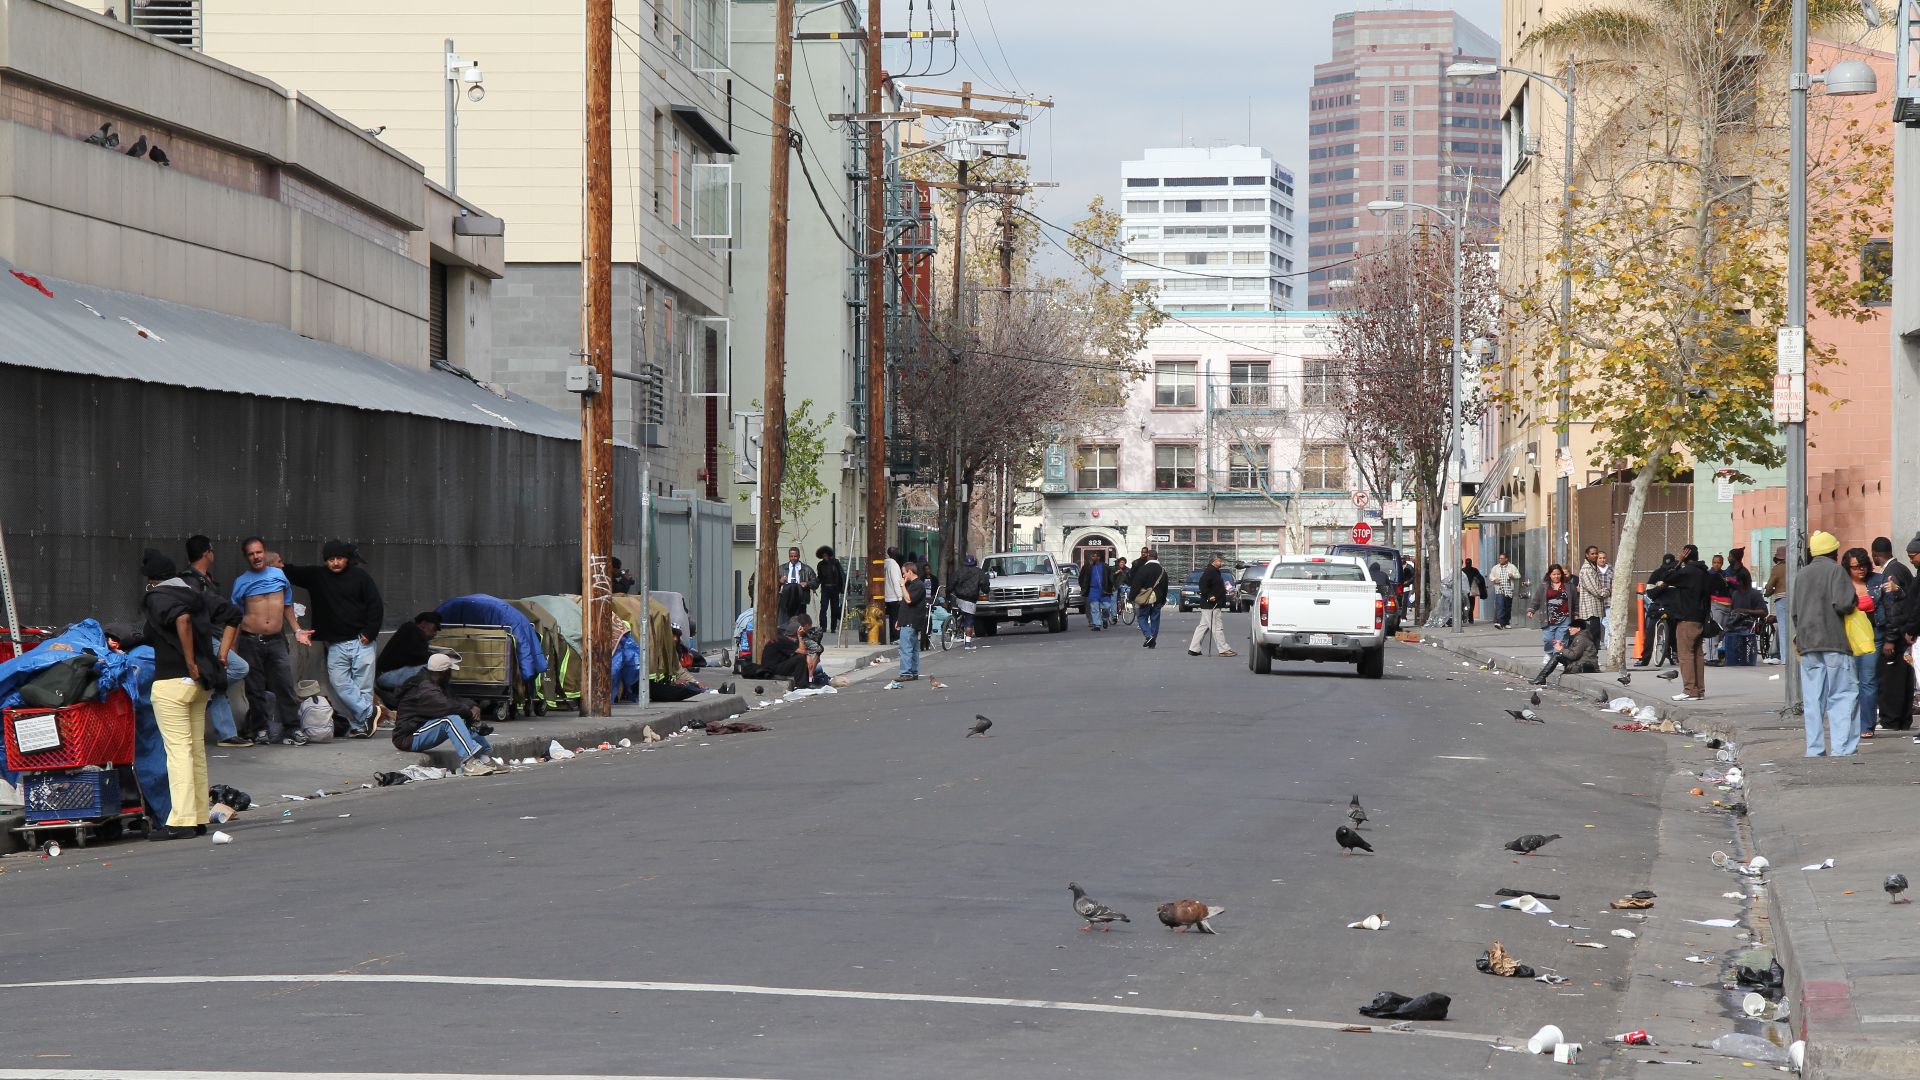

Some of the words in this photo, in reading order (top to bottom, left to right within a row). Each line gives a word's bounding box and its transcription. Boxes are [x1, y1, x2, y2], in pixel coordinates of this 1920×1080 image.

[1776, 376, 1789, 388] NO
[1776, 391, 1803, 401] PARKING
[1353, 528, 1371, 538] STOP
